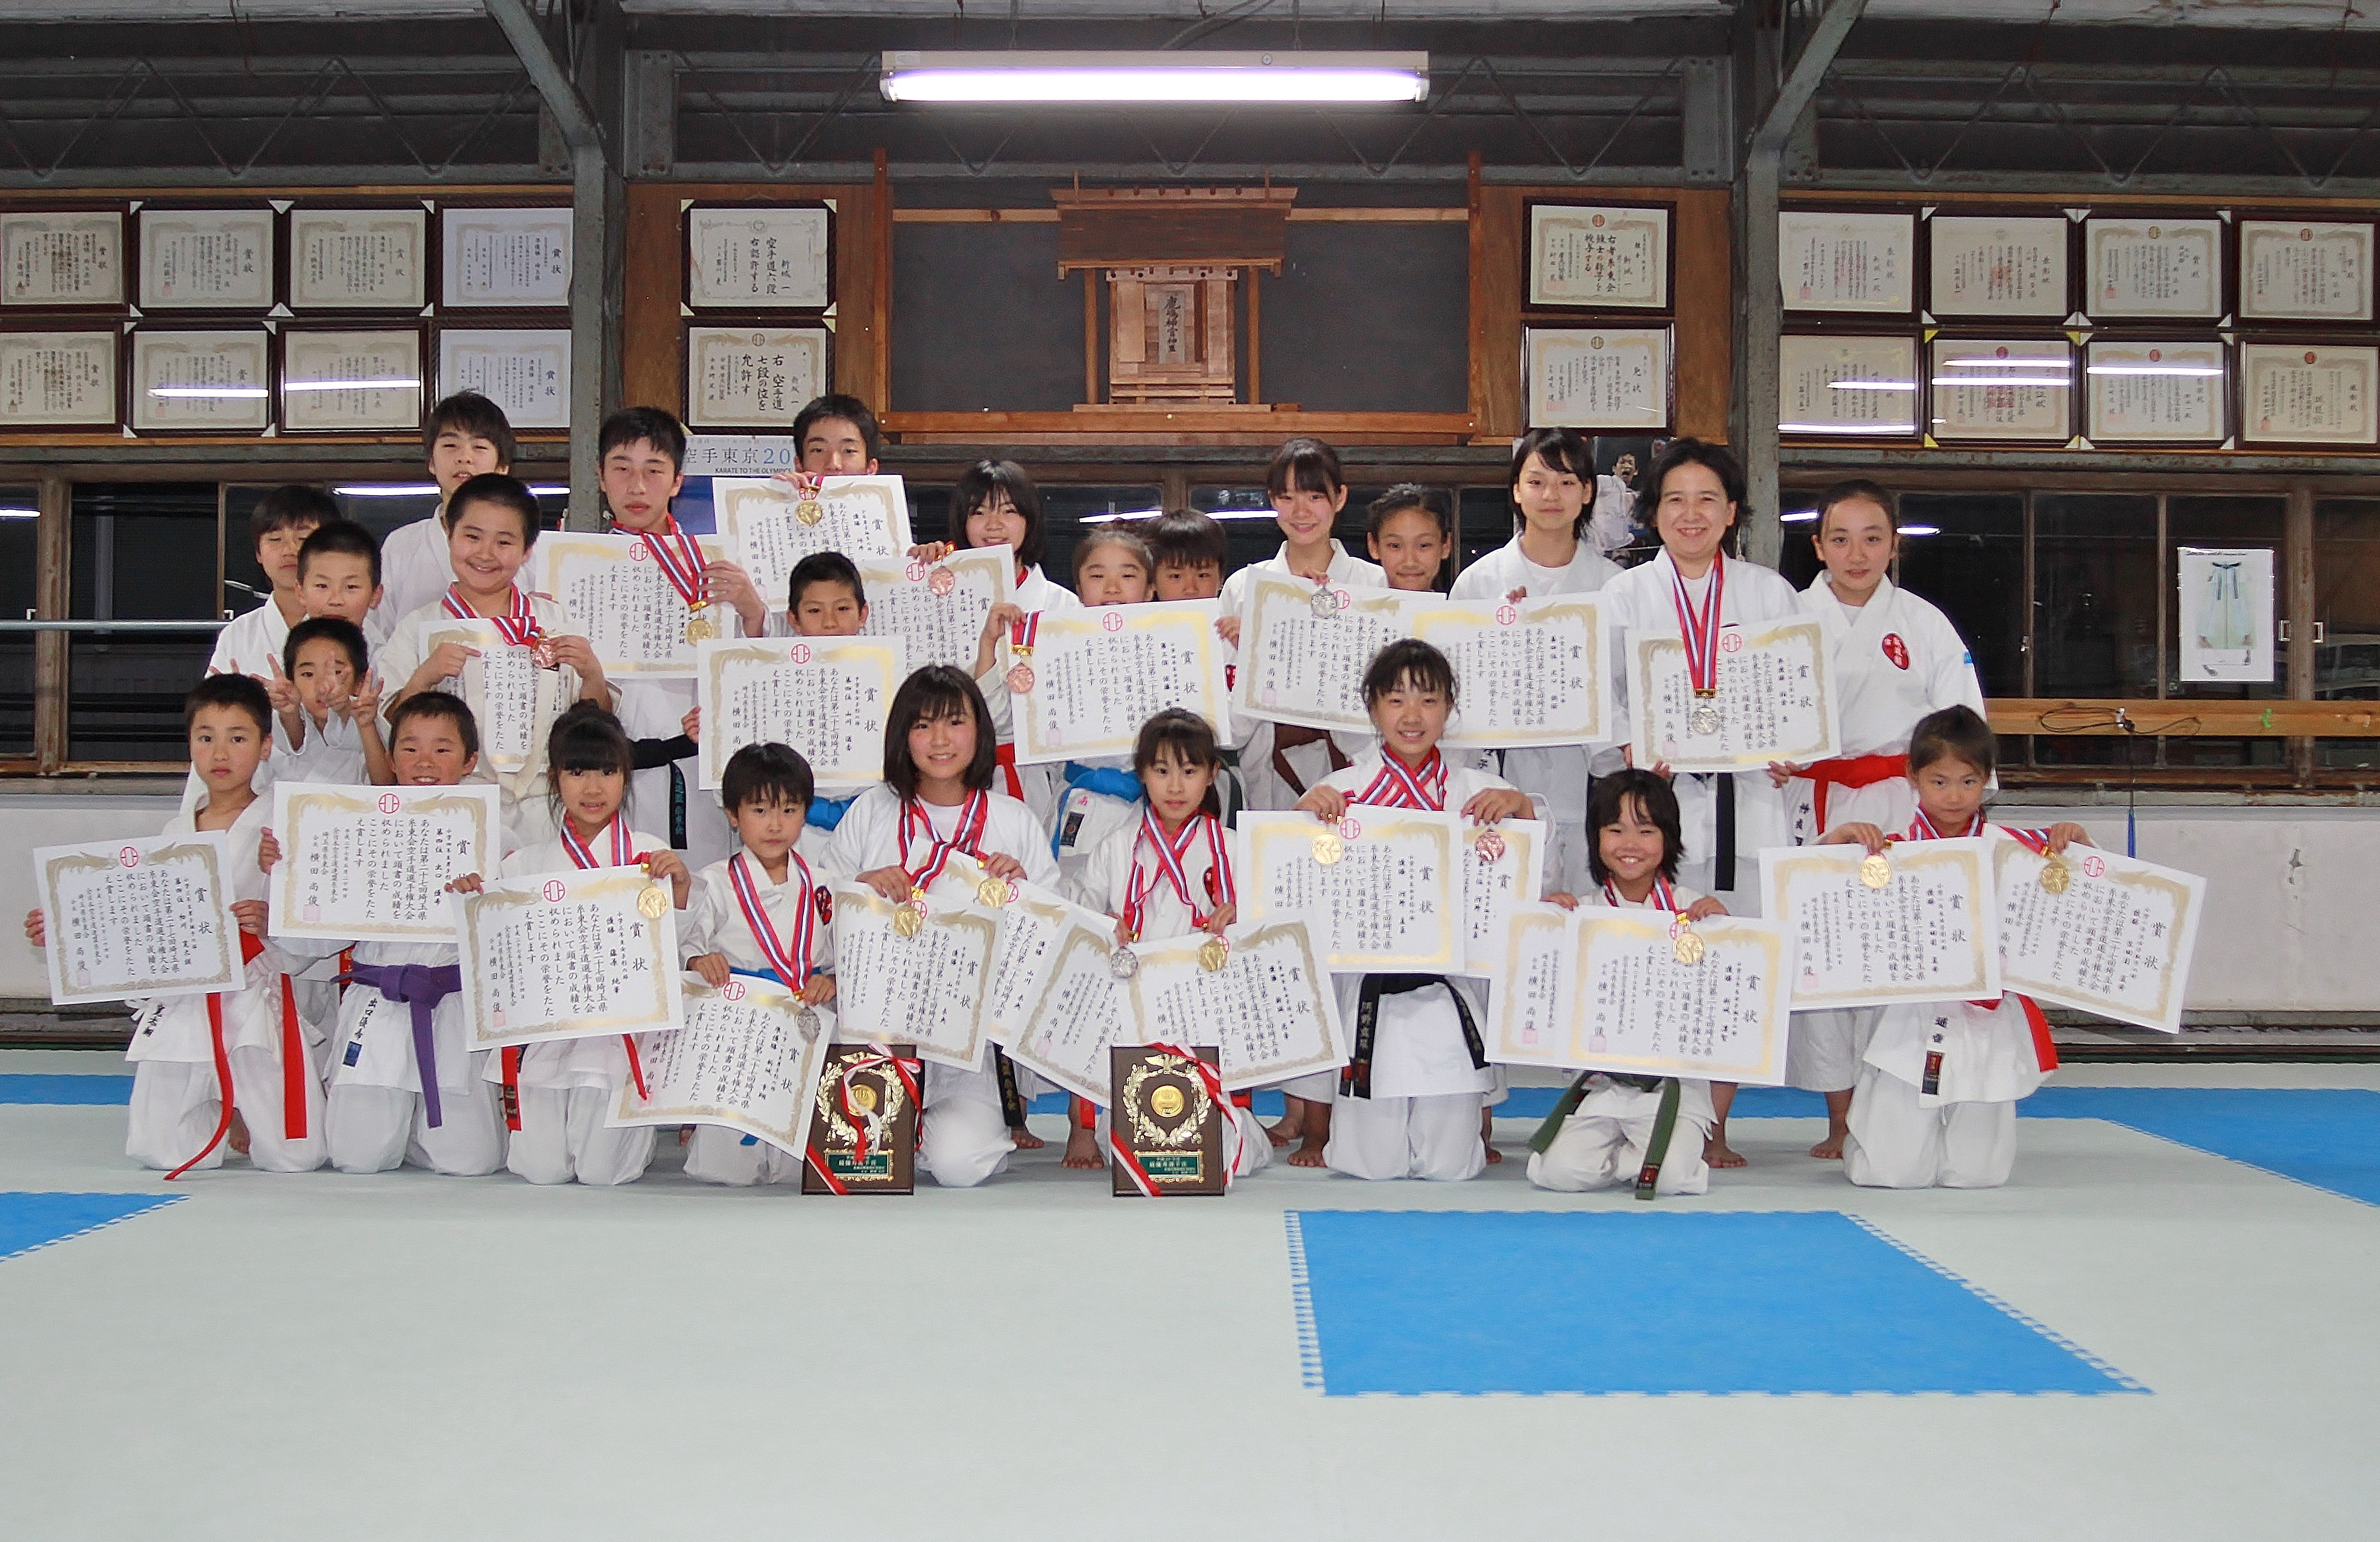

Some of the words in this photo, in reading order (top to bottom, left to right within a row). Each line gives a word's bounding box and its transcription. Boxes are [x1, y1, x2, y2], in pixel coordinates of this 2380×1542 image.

[551, 248, 562, 274] 賞状
[766, 237, 777, 294] 空手道六段
[545, 370, 556, 396] 賞状
[757, 356, 769, 411] 七段の位を
[772, 373, 784, 411] 空手道
[783, 508, 795, 549] え賞します
[872, 519, 888, 556] 賞状
[749, 541, 763, 585] 横田尚俊
[619, 565, 629, 658] ここにその栄誉をたた
[631, 567, 641, 632] 収められました
[889, 588, 898, 634] え賞します
[912, 587, 923, 652] 収められました
[978, 597, 990, 612] 賞
[483, 652, 491, 699] え賞します
[1084, 638, 1095, 686] え賞します
[1108, 637, 1122, 706] 収められました
[1181, 651, 1197, 694] 賞状
[1266, 639, 1278, 689] 横田尚俊
[1328, 614, 1343, 682] 収められました
[1476, 630, 1485, 679] え賞します
[1500, 629, 1509, 699] 収められました
[1535, 628, 1546, 725] あなたは第二十七回埼玉県
[1568, 645, 1584, 691] 賞状
[494, 652, 504, 750] ここにその栄誉をたた
[507, 651, 516, 722] 収められました
[795, 669, 803, 739] 収められました
[1045, 679, 1058, 729] 横田尚俊
[1096, 638, 1112, 734] ここにその栄誉をたた
[1488, 630, 1497, 726] ここにその栄誉をたた
[1524, 629, 1534, 725] 糸東会空手道選手権大会
[1796, 664, 1813, 709] 賞状
[817, 668, 828, 766] 糸東会空手道選手権大会
[831, 668, 839, 766] あなたは第二十七回埼玉県
[864, 688, 878, 732] 賞状
[1662, 694, 1676, 742] 横田尚俊
[312, 834, 318, 847] 会長
[330, 827, 340, 904] 全日本空手道連盟糸東会
[355, 817, 366, 867] え賞します
[366, 818, 378, 919] ここにその栄誉をたた
[380, 818, 391, 891] 収められました
[404, 817, 418, 920] 糸東会空手道選手権大会
[307, 853, 320, 906] 横田尚俊
[392, 819, 404, 920] において頭書の成績を
[418, 818, 430, 921] あなたは第二十七回埼玉県
[1343, 846, 1353, 921] 収められました
[1369, 845, 1380, 950] 糸東会空手道選手権大会
[1383, 845, 1392, 949] あなたは第二十七回埼玉県
[1418, 866, 1434, 913] 賞状
[1497, 874, 1512, 891] 賞
[105, 875, 118, 926] え賞します
[115, 875, 135, 975] ここにその栄誉をたた
[127, 873, 143, 947] 収められました
[148, 870, 169, 973] 糸東会空手道選手権大会
[160, 870, 180, 973] あなたは第二十七回埼玉県
[194, 887, 212, 936] 賞状
[606, 916, 615, 934] 優勝
[1843, 880, 1856, 931] え賞します
[1897, 876, 1913, 982] 糸東会空手道選手権大会
[1910, 876, 1926, 981] あなたは第二十七回埼玉県
[1948, 894, 1967, 943] 賞状
[1998, 901, 2017, 957] 横田尚俊
[2069, 881, 2093, 956] 収められました
[71, 916, 88, 971] 横田尚俊
[496, 932, 506, 979] 埼玉県糸東会
[524, 910, 536, 963] え賞します
[549, 907, 565, 985] 収められました
[590, 904, 607, 1012] あなたは第二十七回埼玉県
[629, 922, 648, 972] 賞状
[876, 922, 891, 973] え賞します
[1800, 921, 1814, 976] 横田尚俊
[2051, 879, 2080, 981] ここにその栄誉をたた
[2089, 888, 2118, 990] 糸東会空手道選手権大会
[2102, 891, 2131, 994] あなたは第二十七回埼玉県
[2144, 922, 2167, 970] 賞状
[488, 957, 501, 1012] 横田尚俊
[504, 925, 517, 1006] 全日本空手道連盟糸東会
[537, 910, 554, 1017] ここにその栄誉をたた
[576, 905, 595, 1013] 糸東会空手道選手権大会
[915, 930, 939, 1035] 糸東会空手道選手権大会
[925, 933, 951, 1037] あなたは第二十七回埼玉県
[959, 961, 978, 1010] 賞状
[1642, 946, 1655, 997] え賞します
[1043, 988, 1071, 1042] 横田尚俊
[1194, 968, 1210, 1018] え賞します
[1239, 955, 1269, 1060] 糸東会空手道選手権大会
[1251, 954, 1280, 1057] あなたは第二十七回埼玉県
[1287, 966, 1310, 1016] 賞状
[1524, 974, 1539, 1030] 横田尚俊
[1594, 981, 1608, 1038] 横田尚俊
[1650, 946, 1669, 1052] ここにその栄誉をたた
[1743, 974, 1761, 1024] 賞状
[689, 1003, 706, 1052] え賞します
[689, 1003, 718, 1101] ここにその栄誉をたた
[707, 1005, 732, 1074] 収められました
[728, 1008, 758, 1106] 糸東会空手道選手権大会
[741, 1012, 771, 1109] あなたは第二十七回埼玉県
[780, 1048, 801, 1094] 賞状
